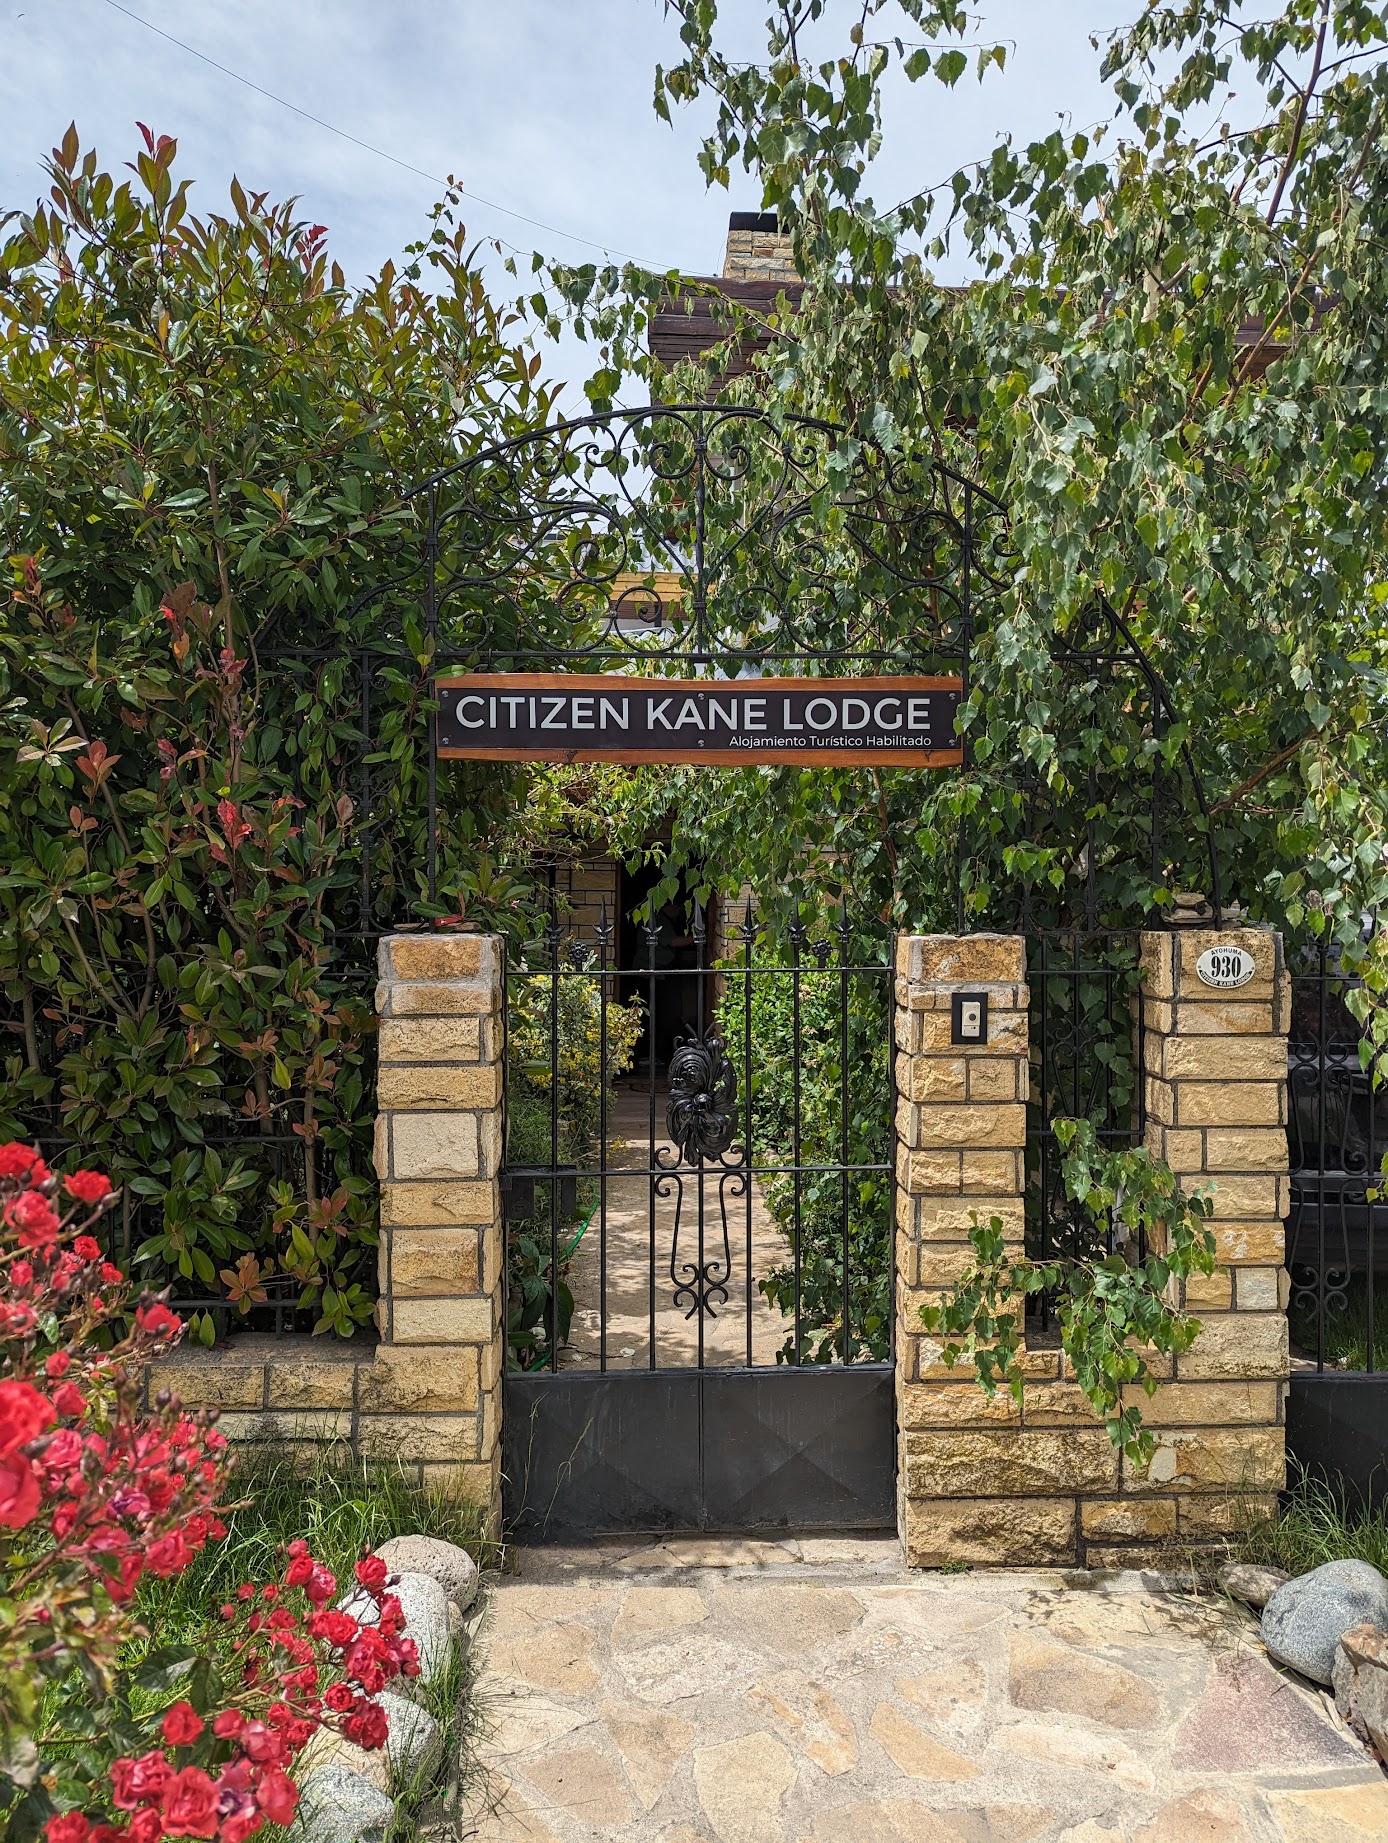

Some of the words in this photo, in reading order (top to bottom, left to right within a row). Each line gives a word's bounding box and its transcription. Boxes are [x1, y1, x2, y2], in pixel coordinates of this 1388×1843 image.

[456, 695, 629, 730] CITIZEN
[647, 697, 767, 731] KANE
[783, 697, 931, 731] LODGE
[729, 735, 807, 749] Alojamiento
[809, 734, 863, 747] Turístico
[867, 735, 932, 747] Habilitado
[1210, 947, 1242, 957] AYOHUMA
[1211, 955, 1242, 978] 930
